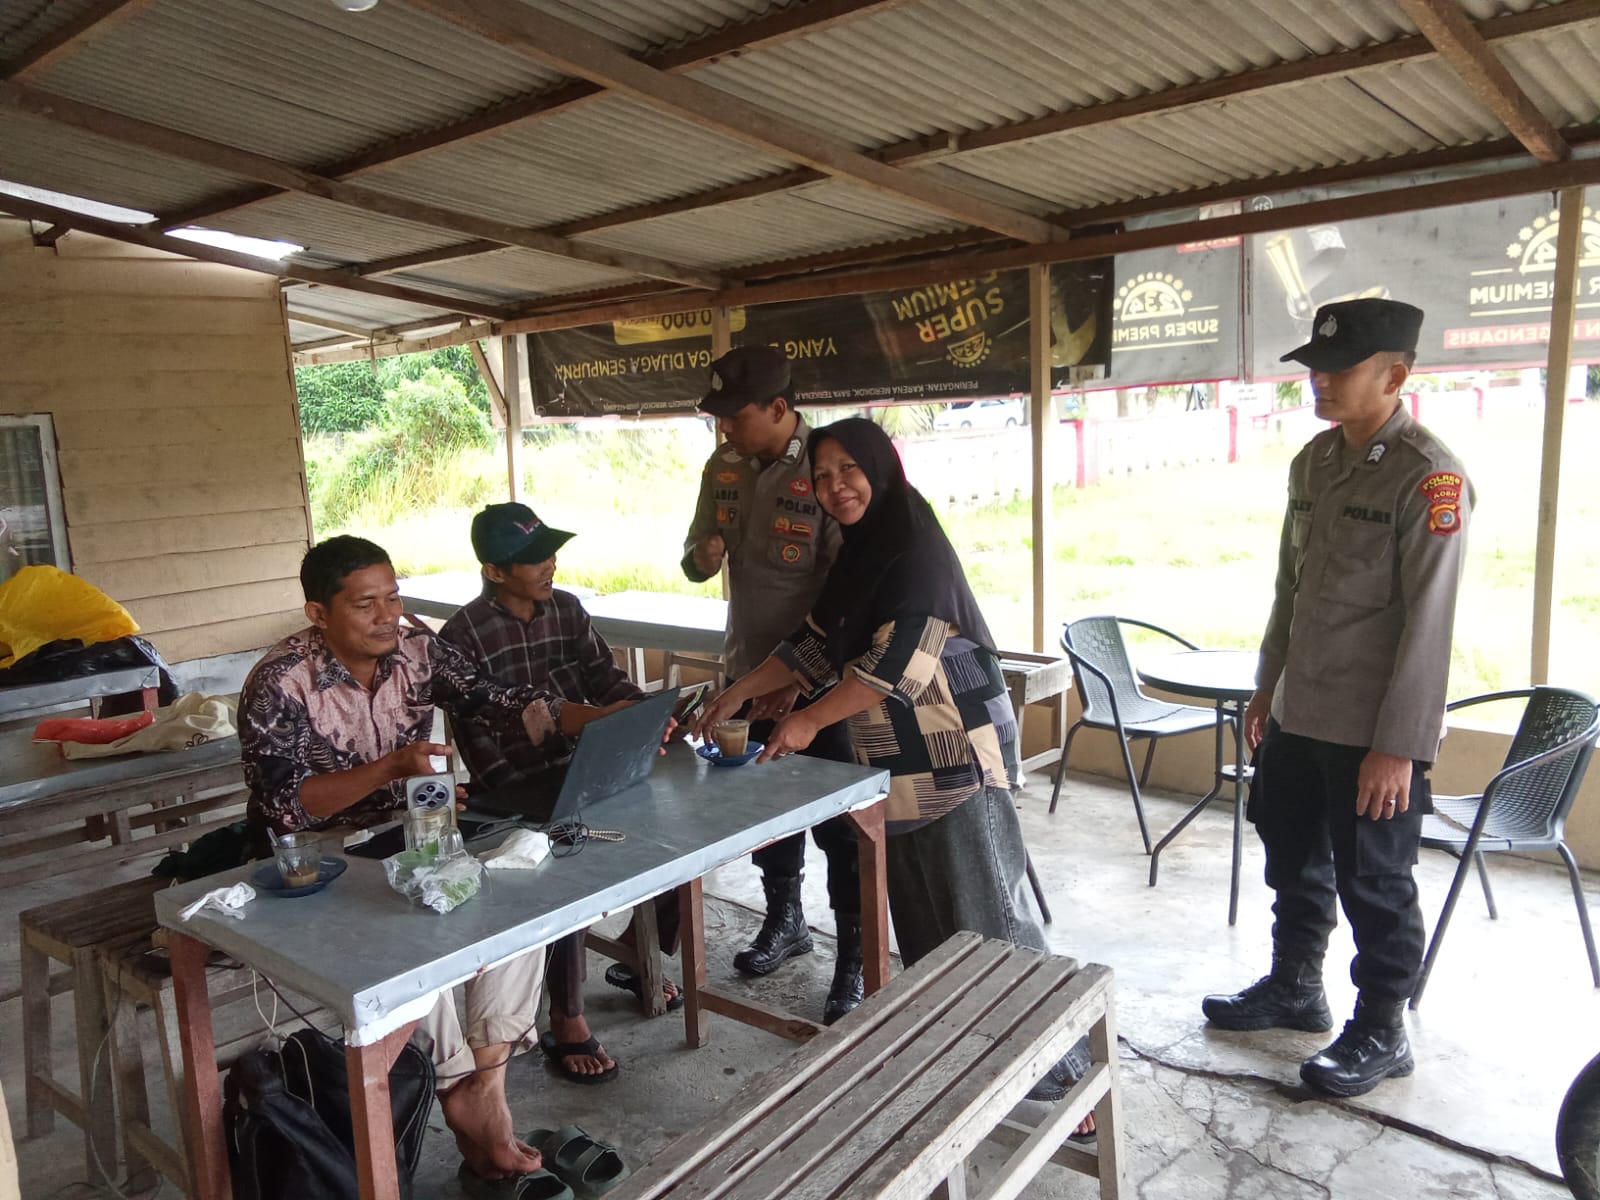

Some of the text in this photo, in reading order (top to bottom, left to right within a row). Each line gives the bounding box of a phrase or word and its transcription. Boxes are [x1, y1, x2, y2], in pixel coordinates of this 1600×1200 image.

[915, 287, 1004, 343] SUPER
[785, 336, 838, 359] YANG
[555, 358, 627, 381] SEMPURNA
[629, 352, 684, 373] DIJAGA
[833, 389, 851, 398] SAYA
[891, 384, 924, 394] KARENA
[925, 380, 979, 391] PERINGATAN:
[1423, 475, 1461, 490] POLRES
[776, 497, 817, 516] POLRI
